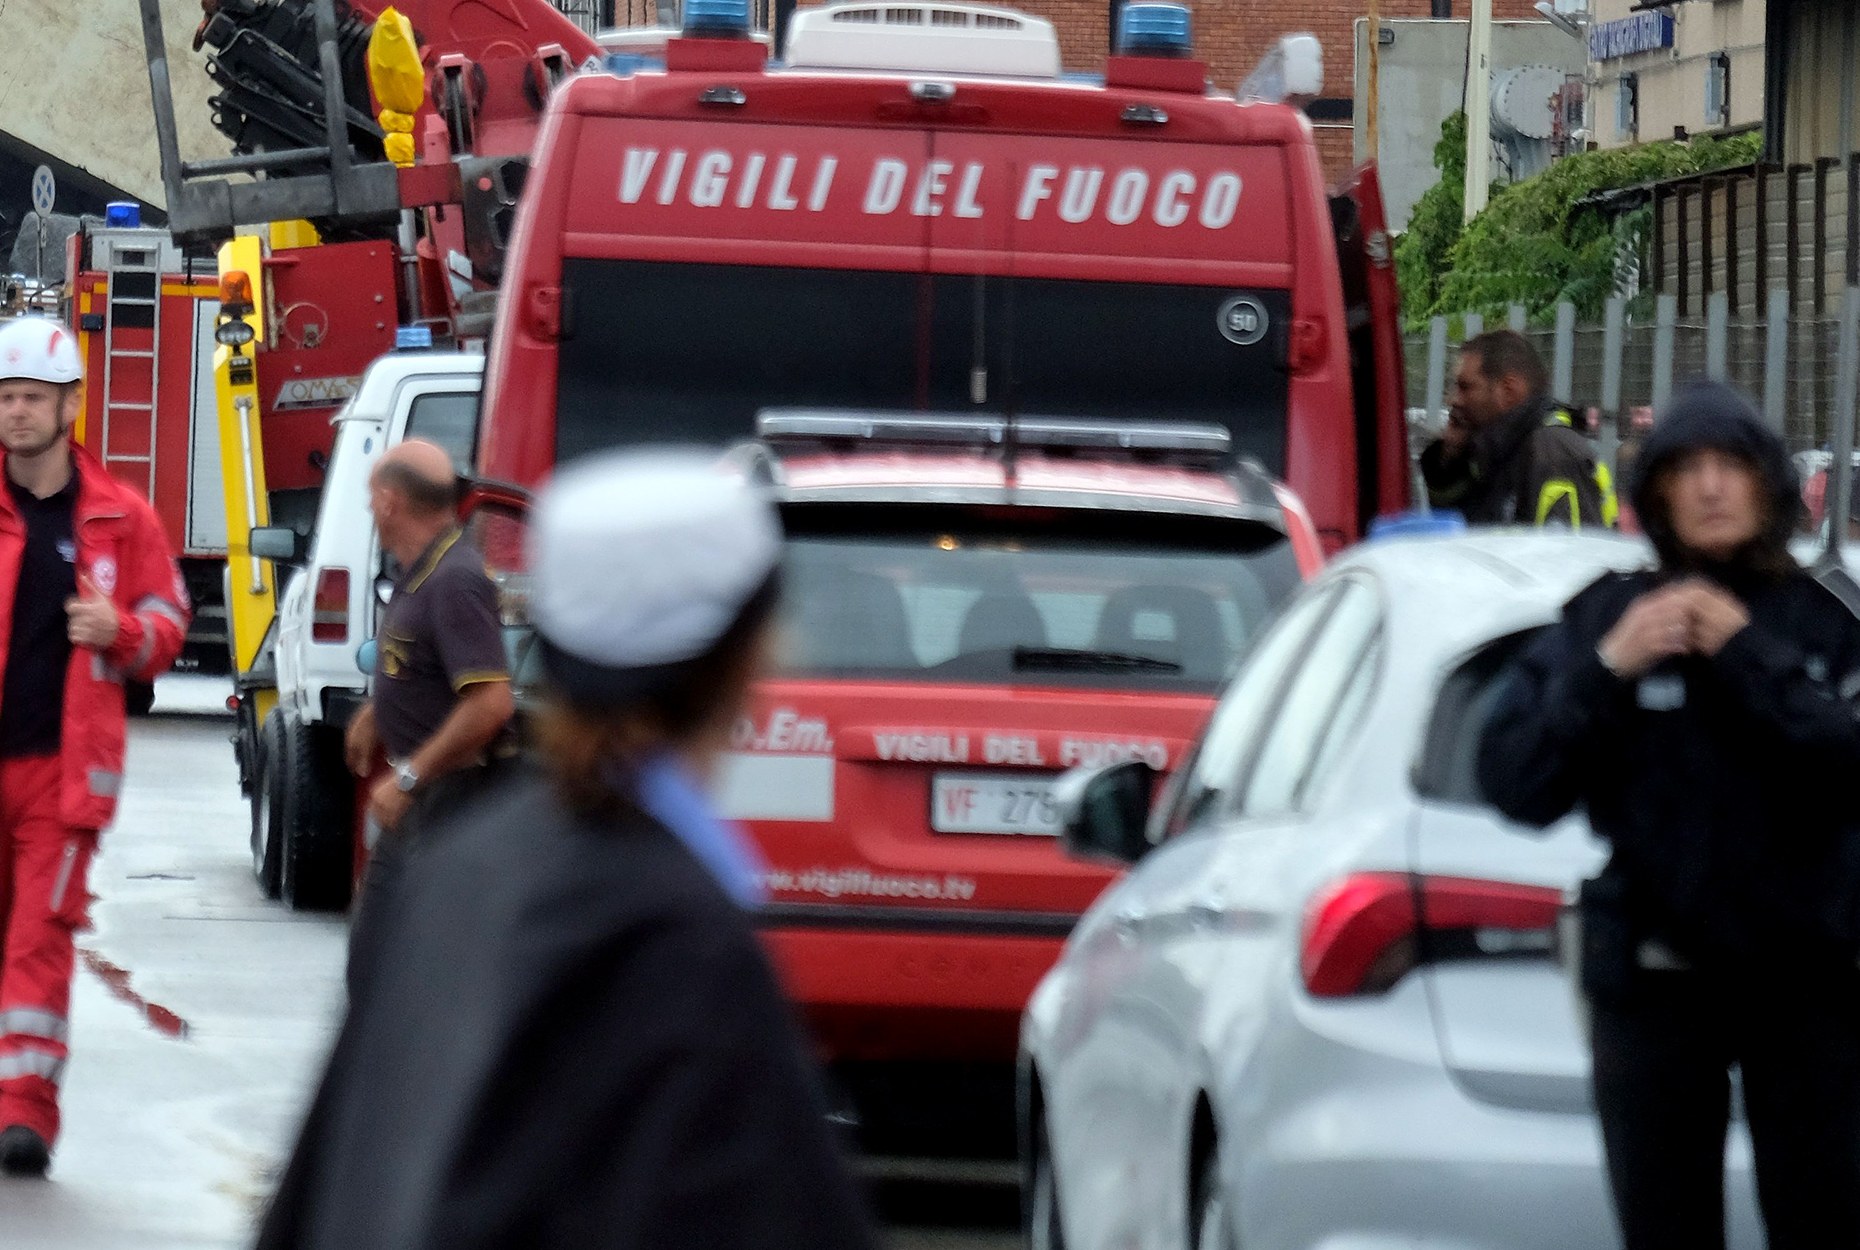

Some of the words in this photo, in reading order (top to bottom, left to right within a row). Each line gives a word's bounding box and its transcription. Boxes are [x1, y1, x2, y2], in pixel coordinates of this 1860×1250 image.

[618, 148, 837, 211] VIGILI
[865, 160, 984, 218] DEL
[1017, 167, 1243, 229] FUOCO
[874, 733, 969, 761] VIGILI
[984, 735, 1044, 765] DEL
